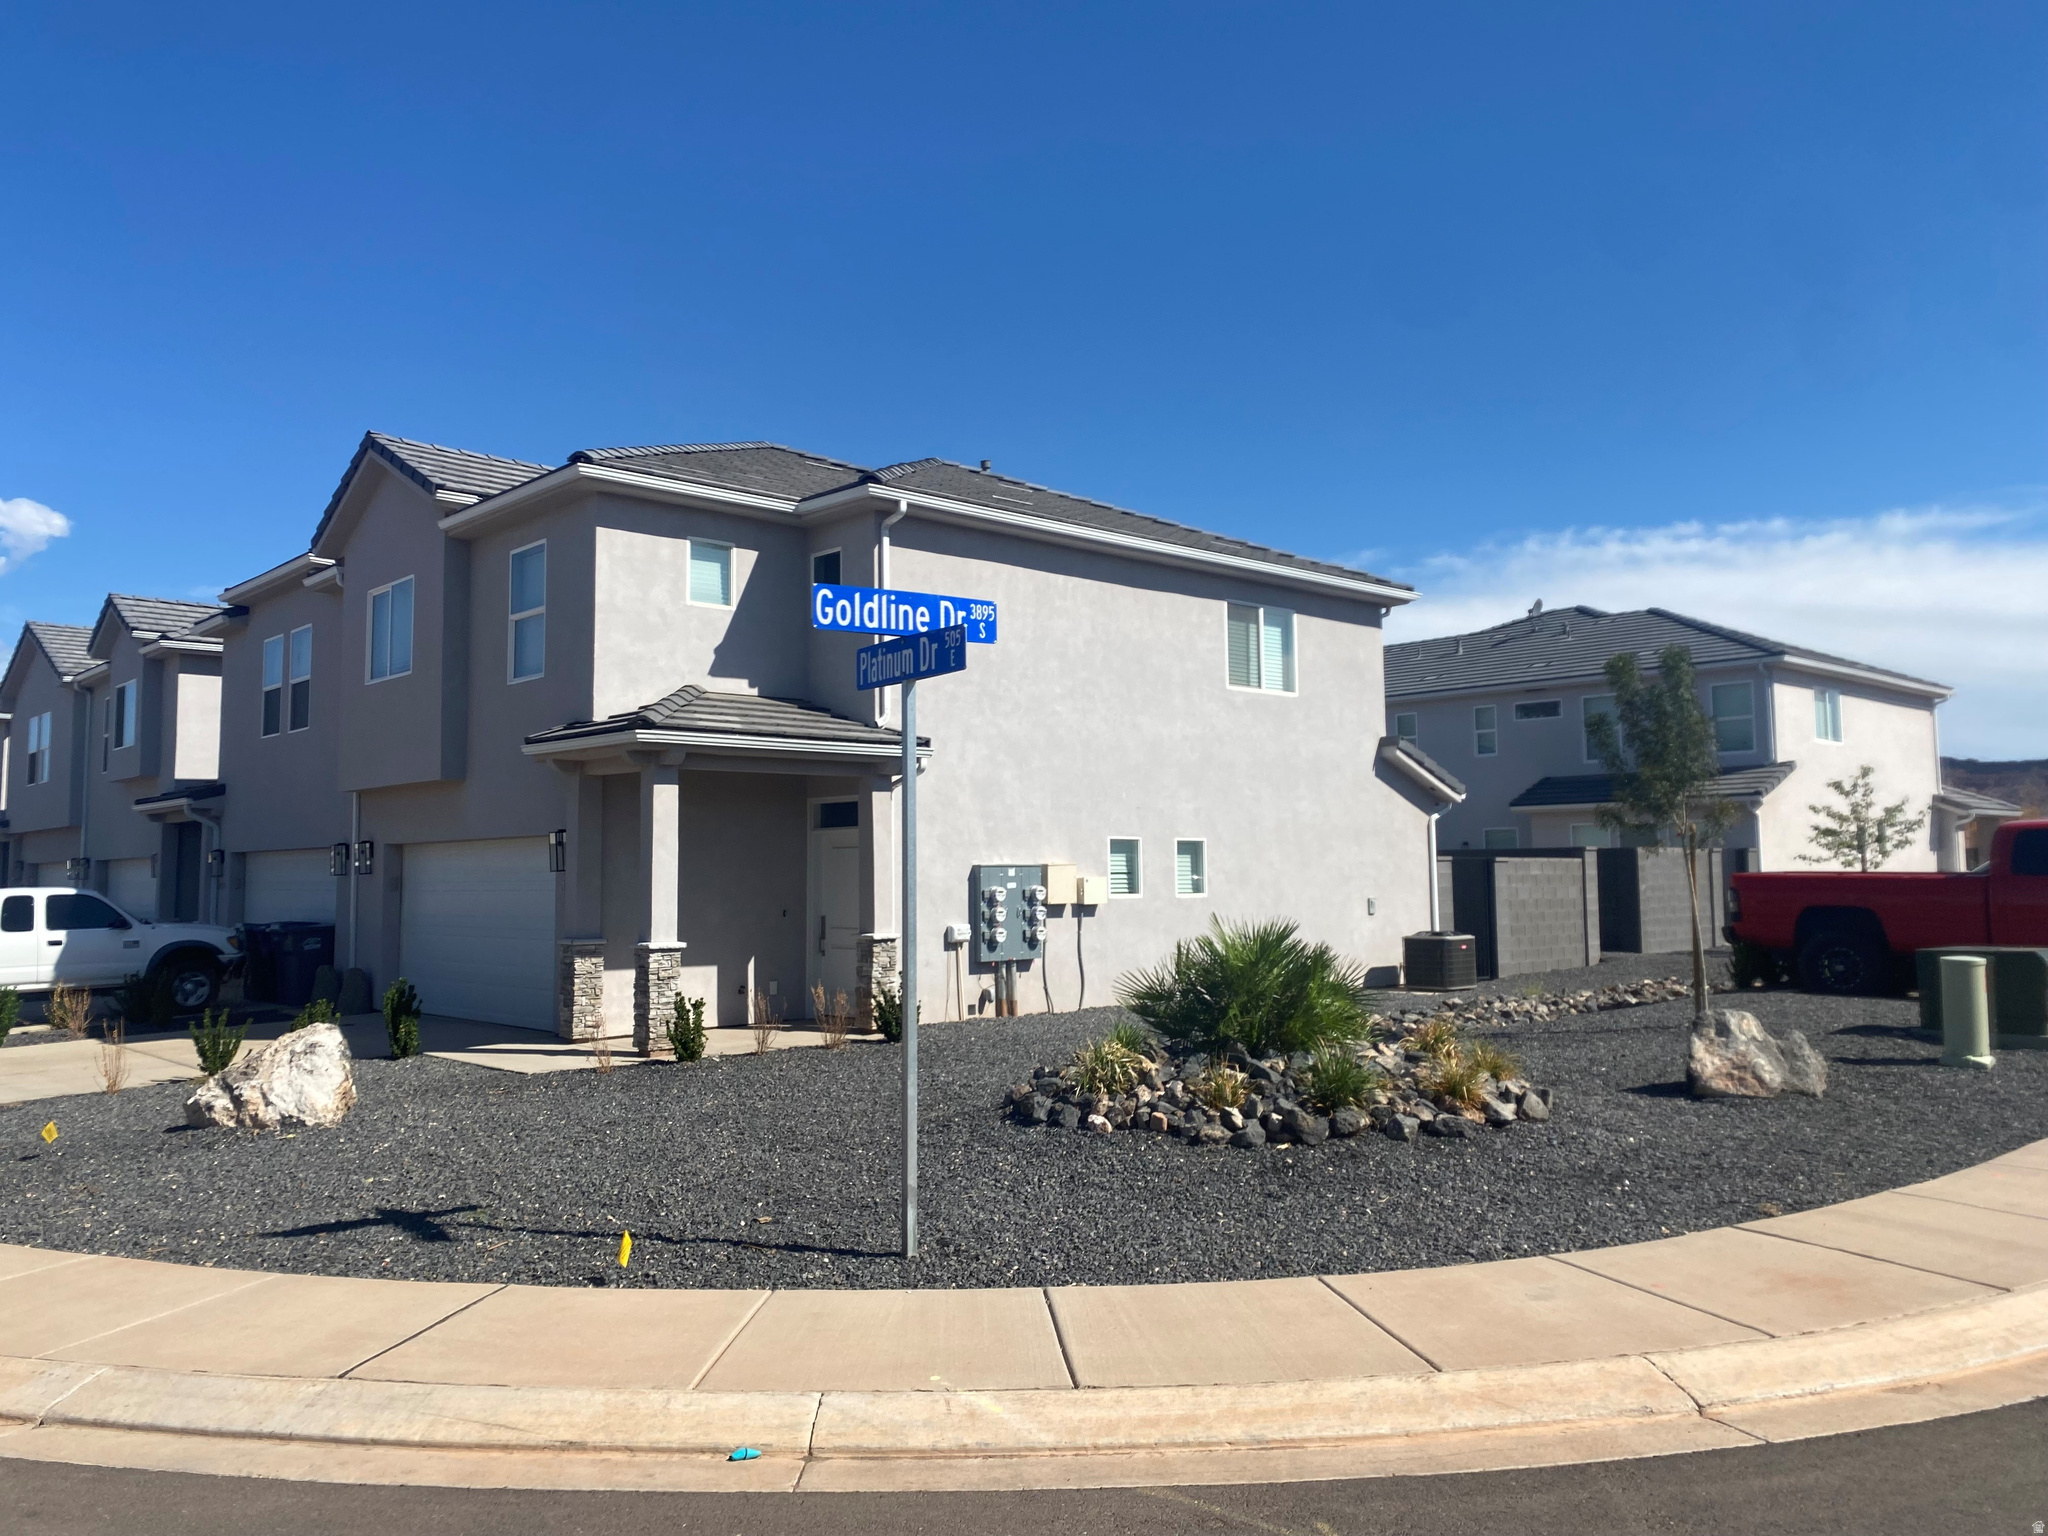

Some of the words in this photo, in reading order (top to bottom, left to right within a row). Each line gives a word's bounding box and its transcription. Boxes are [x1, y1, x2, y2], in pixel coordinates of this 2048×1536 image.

[816, 588, 930, 632] Goldline
[940, 600, 967, 629] Dr
[970, 603, 995, 621] 3895
[944, 629, 961, 649] 505
[979, 622, 986, 639] S
[860, 647, 914, 686] Platinum
[919, 636, 938, 672] Dr
[950, 649, 956, 667] E
